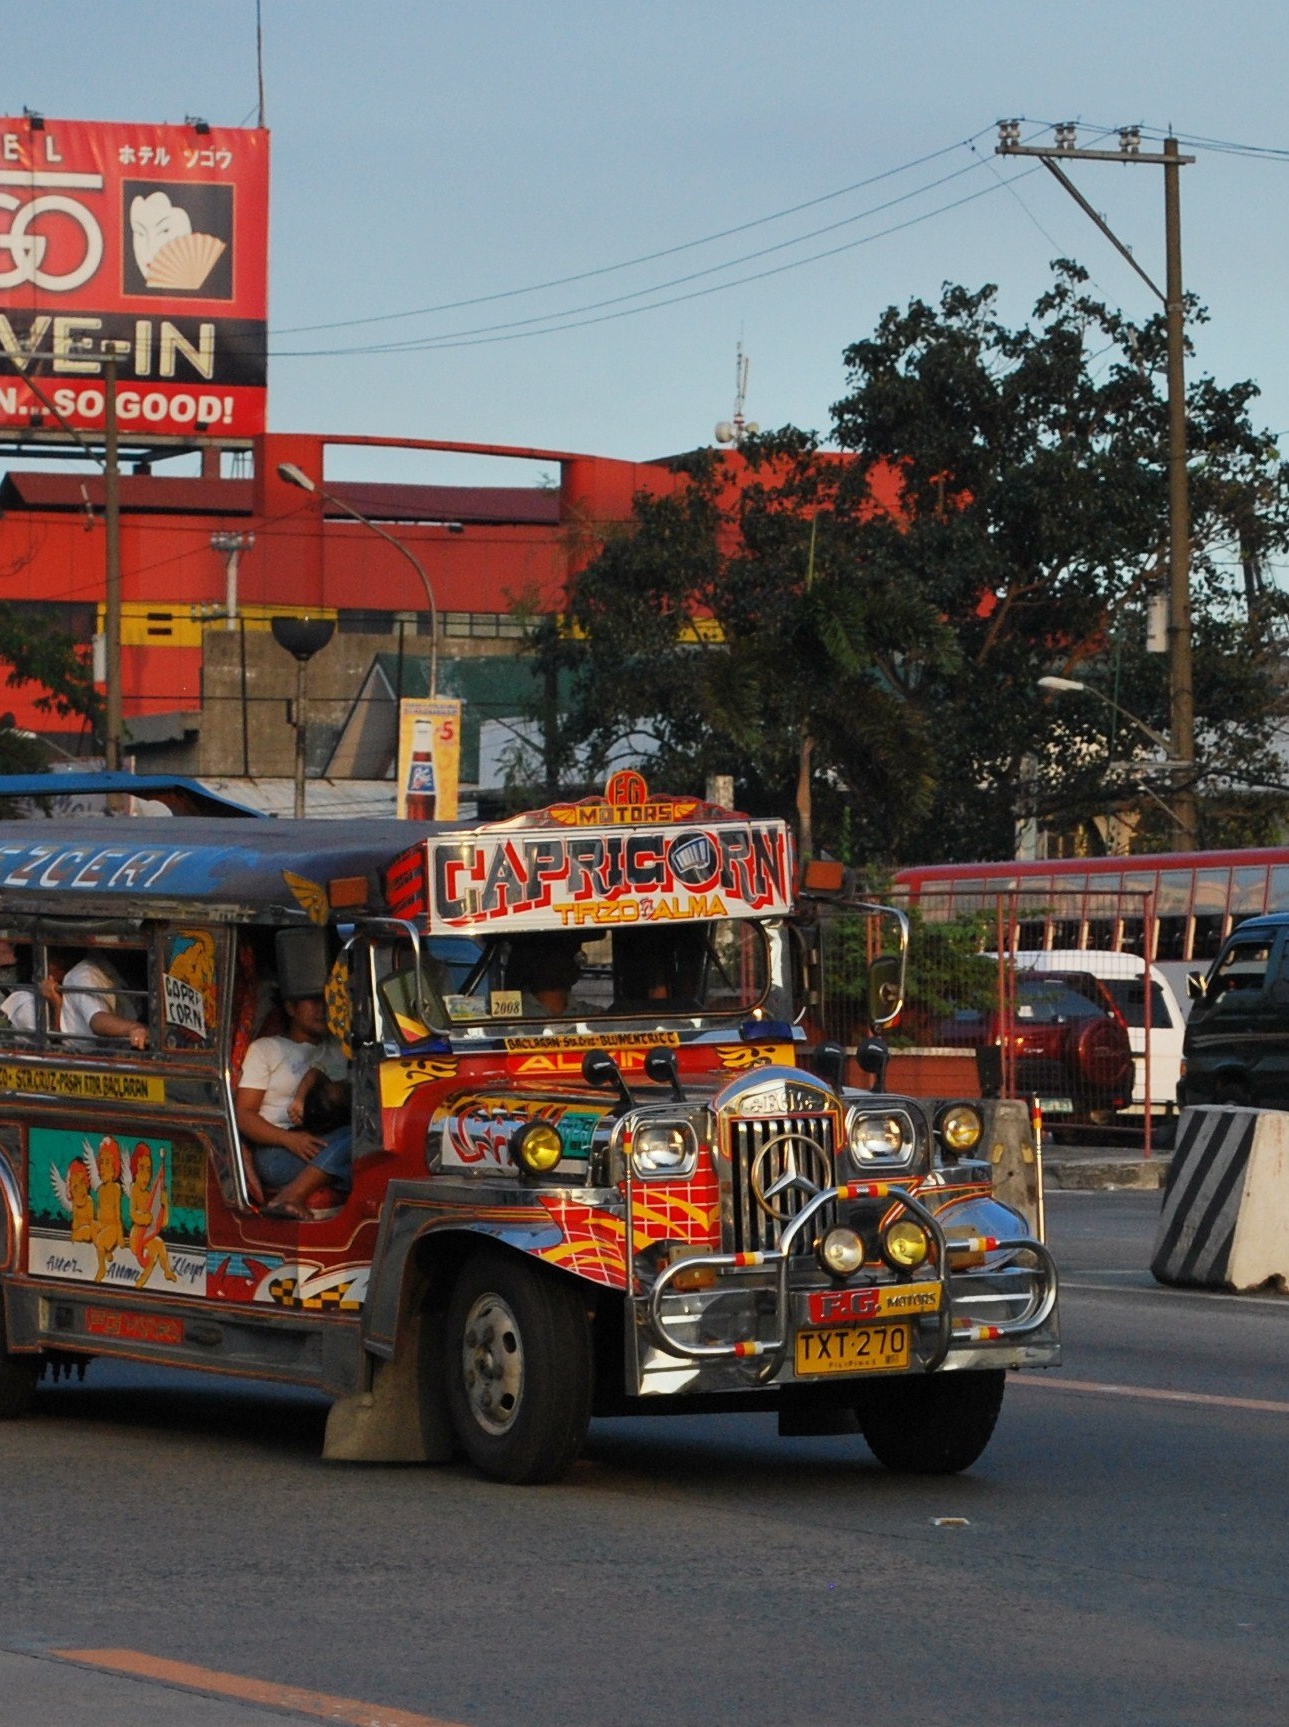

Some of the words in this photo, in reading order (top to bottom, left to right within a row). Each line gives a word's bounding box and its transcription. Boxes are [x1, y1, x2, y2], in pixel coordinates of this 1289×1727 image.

[119, 145, 171, 167] ホテル
[183, 147, 233, 169] ソゴウ
[114, 391, 233, 425] GOOD!
[580, 805, 673, 825] MOTORS
[433, 827, 789, 926] CAPRICORN
[553, 899, 640, 926] TIRZO
[653, 894, 729, 920] ALMA
[169, 1003, 203, 1031] CORN
[494, 1001, 521, 1016] 2008
[518, 1049, 647, 1073] ALIN
[887, 1292, 936, 1309] MOTORS
